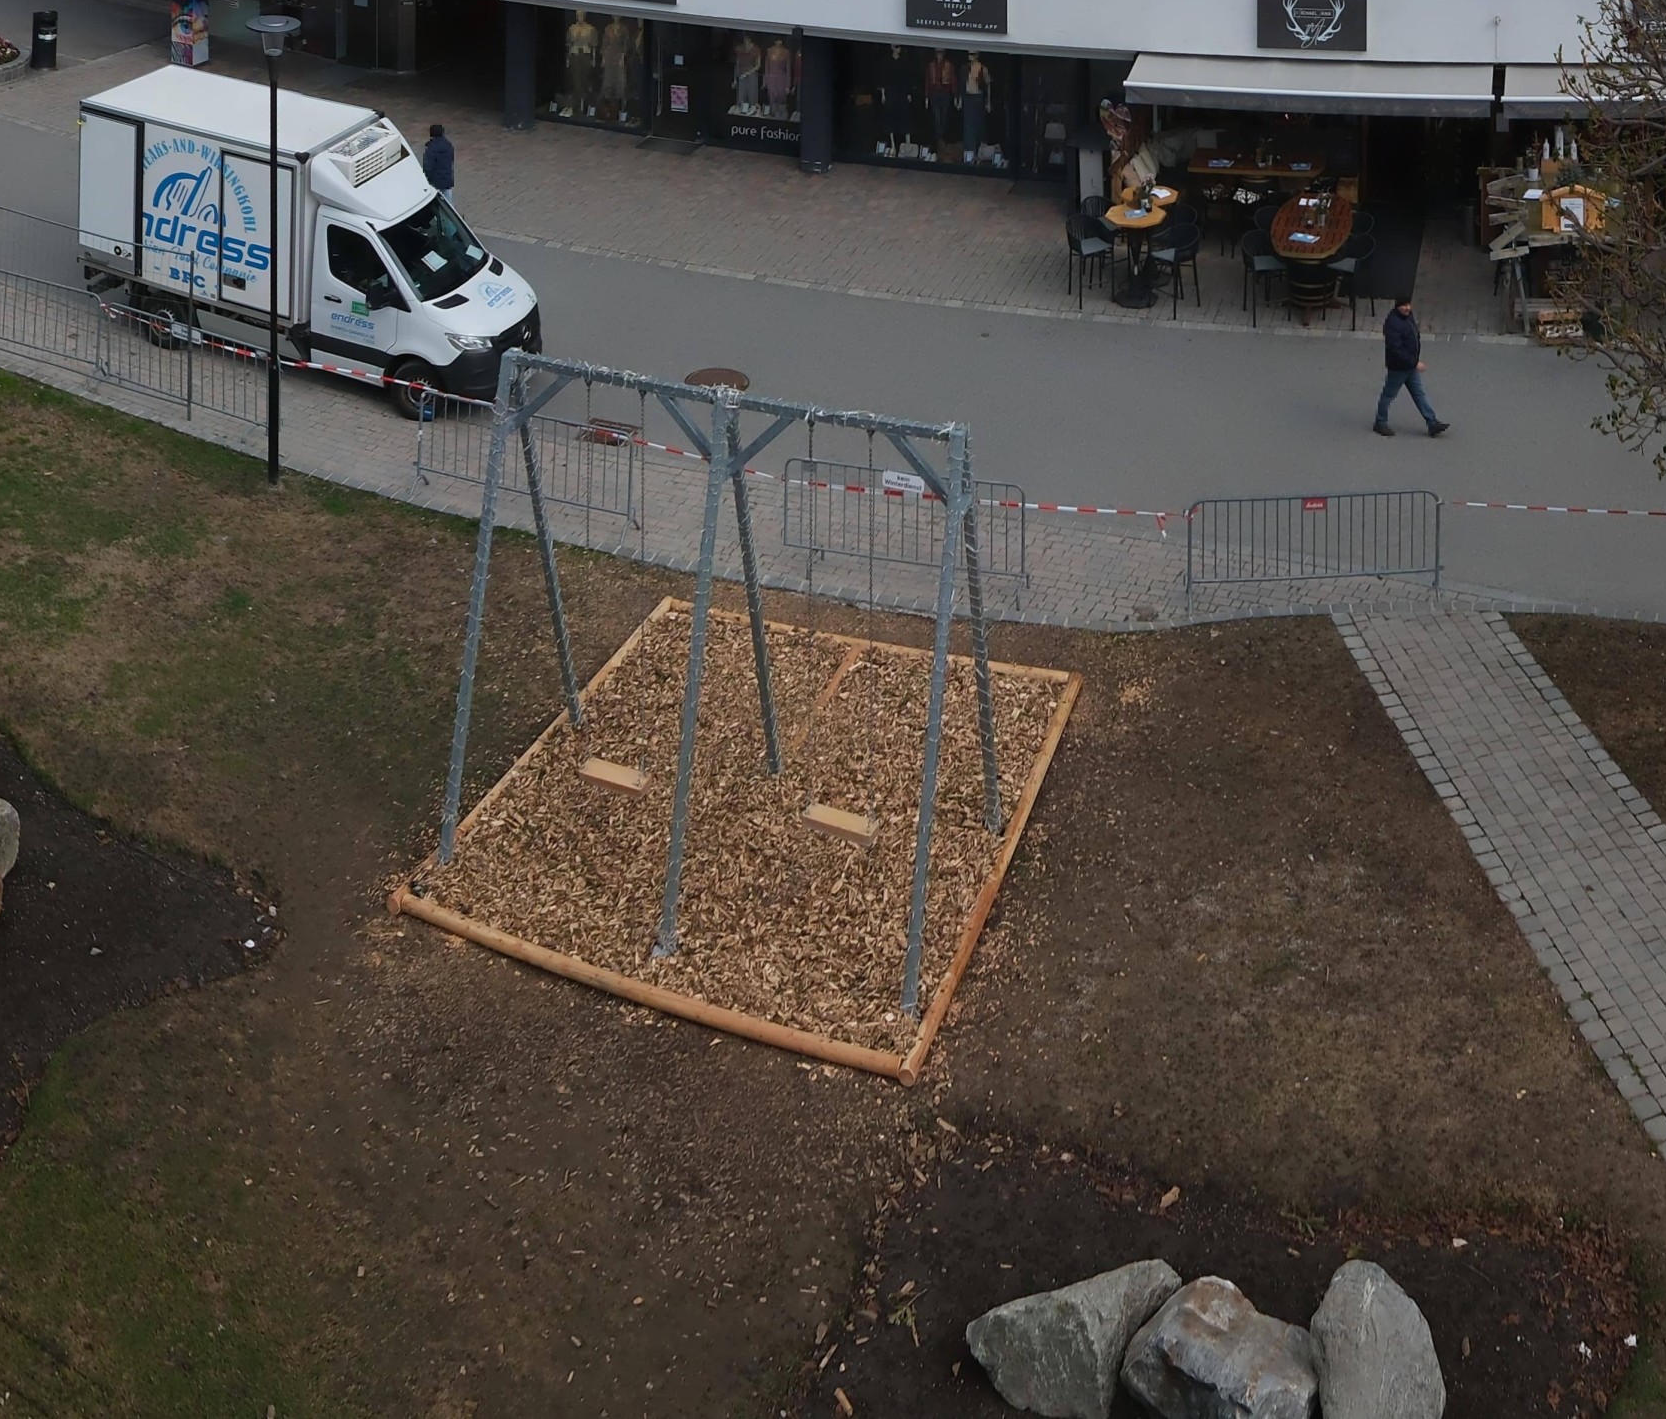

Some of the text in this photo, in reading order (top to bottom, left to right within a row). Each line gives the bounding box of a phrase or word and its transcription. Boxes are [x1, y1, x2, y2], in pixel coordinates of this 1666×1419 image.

[943, 2, 972, 10] SEEFELD
[916, 19, 945, 27] SEEFELD
[947, 21, 983, 29] SHOPPING
[731, 125, 757, 137] pure
[143, 212, 271, 271] ndress
[331, 312, 375, 330] endress
